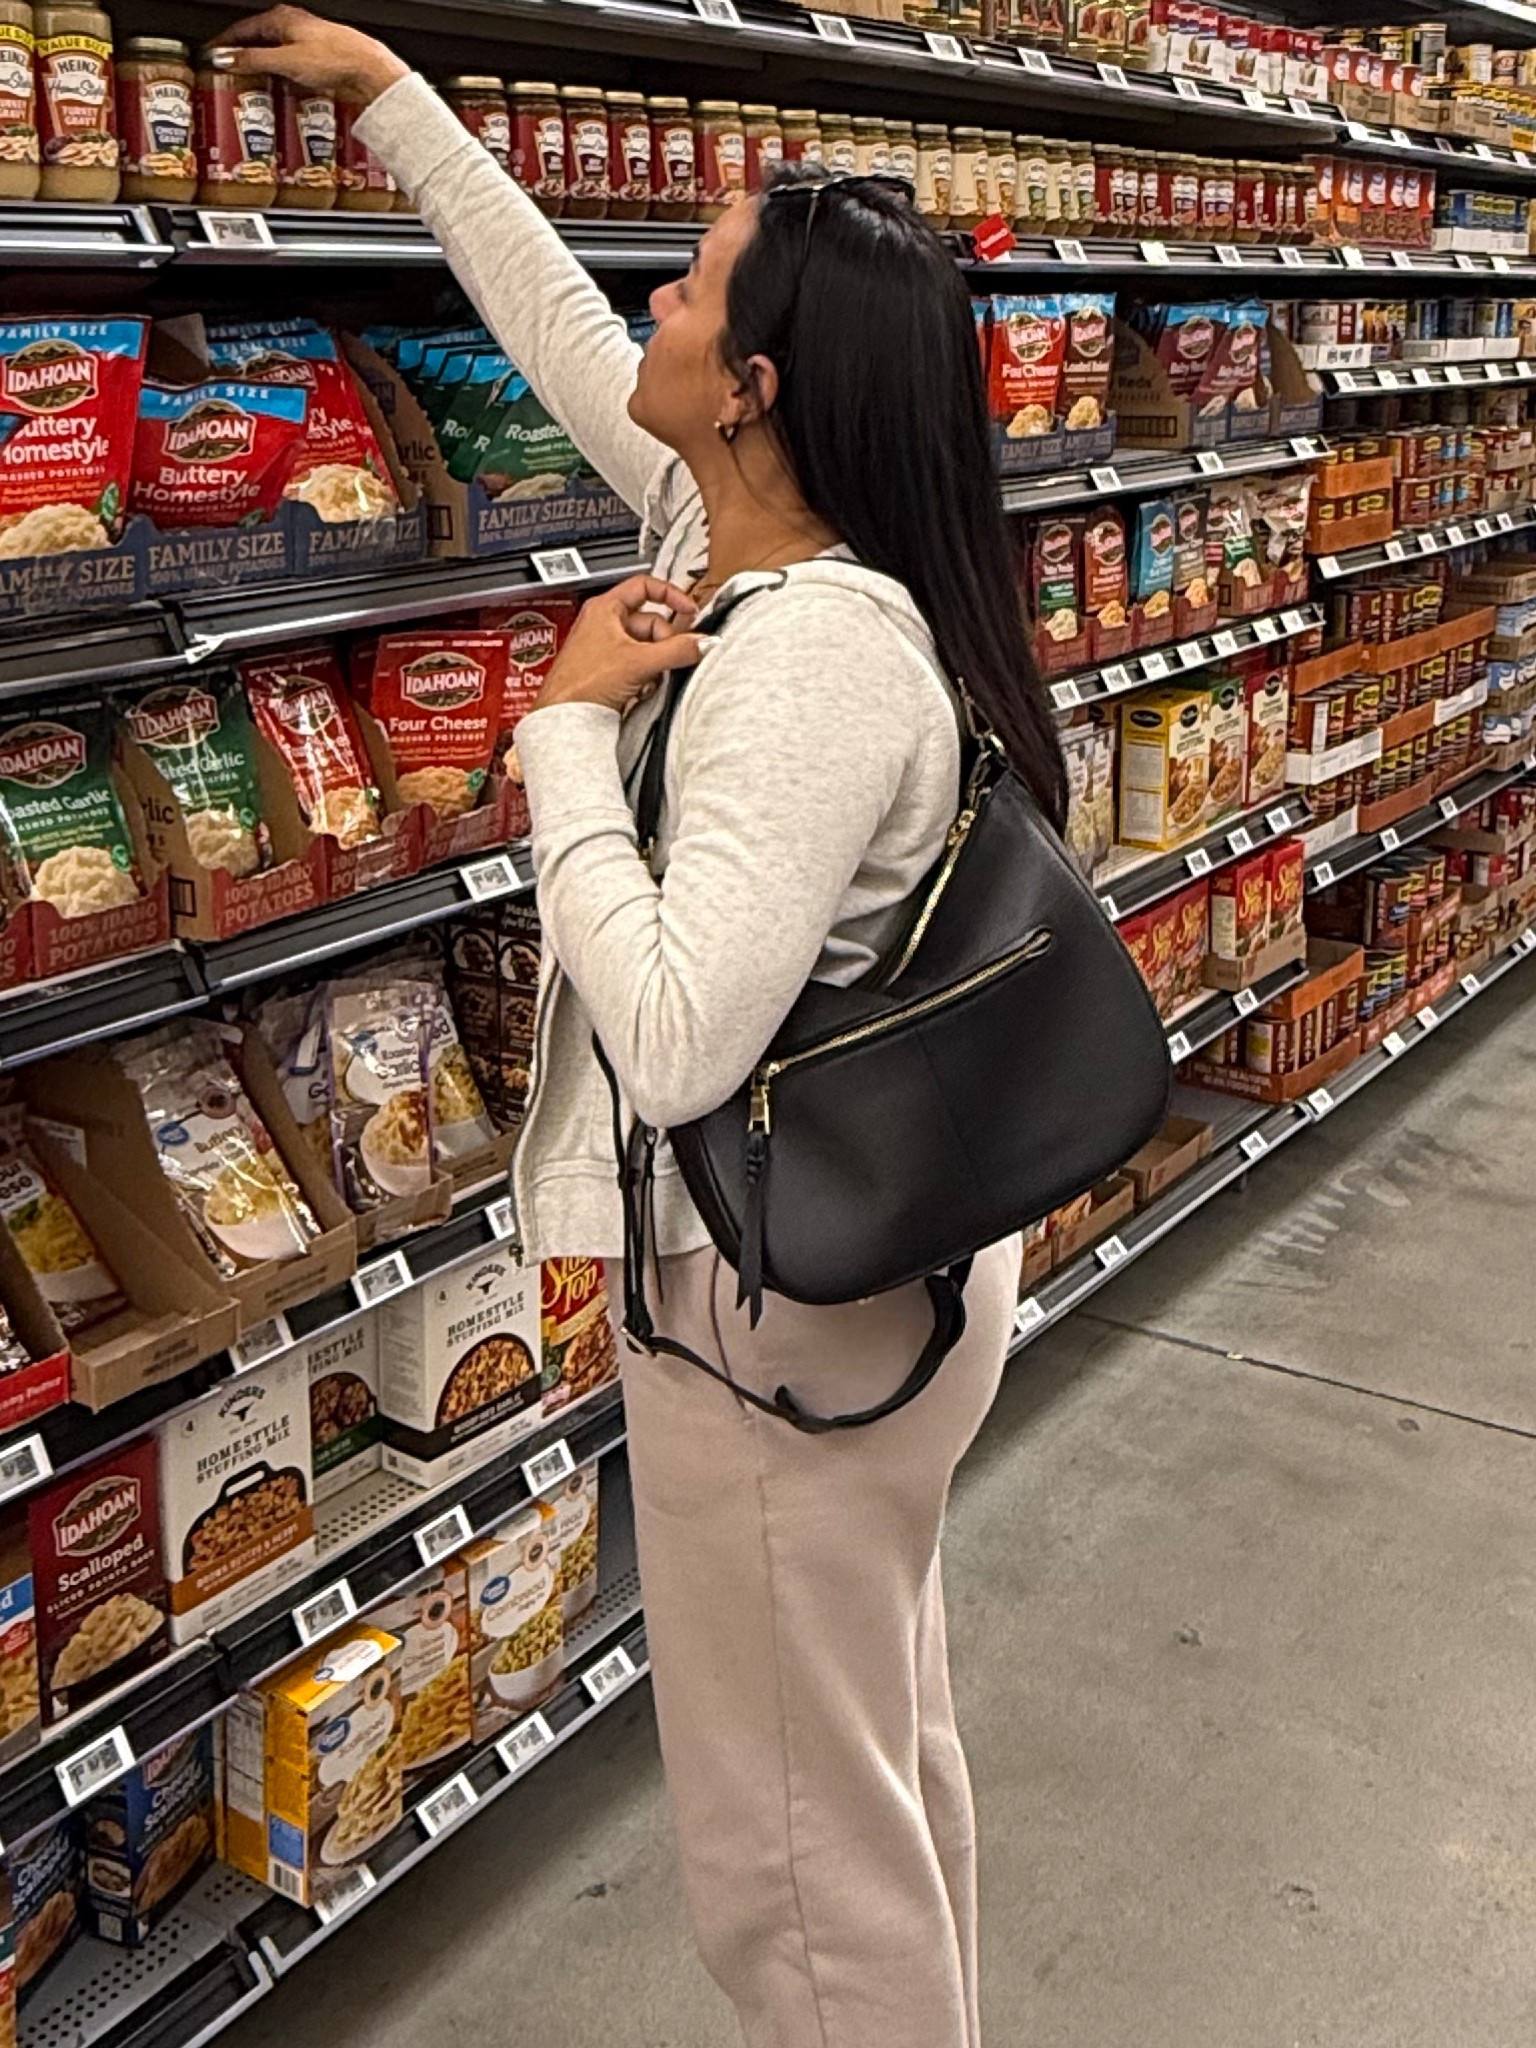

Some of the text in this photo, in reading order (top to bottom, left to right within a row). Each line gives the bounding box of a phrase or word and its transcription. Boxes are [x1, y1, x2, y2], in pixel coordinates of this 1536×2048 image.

[0, 51, 26, 66] EINZ
[57, 59, 99, 75] HEINZ
[154, 87, 187, 101] HEINZ
[64, 115, 97, 126] GRAVY
[69, 325, 108, 337] SIZE
[7, 359, 92, 394] IDAHOAN
[225, 385, 269, 399] SIZE
[167, 418, 250, 452] IDAHOAN
[133, 483, 262, 504] Homestyle
[159, 464, 248, 489] Buttery
[478, 496, 629, 532] FAMILY SIZE FAMIL
[148, 531, 286, 571] FAMILY SIZE
[78, 555, 135, 587] SIZE
[511, 628, 554, 651] AHOAN
[404, 670, 480, 696] IDAHOAN
[138, 699, 212, 738] IDAHOAN
[389, 715, 488, 732] Four Cheese
[2, 738, 80, 775] DAHOAN
[9, 790, 111, 819] oasted Garlic
[223, 881, 315, 929] POTATOES
[50, 919, 158, 968] POTATOES
[446, 1302, 525, 1348] STUFFING MIX
[447, 1290, 525, 1338] HOMESTYLE
[196, 1414, 290, 1473] HOMESTYLE
[196, 1426, 291, 1484] STUFFING MIX
[60, 1484, 136, 1549] IDAHOAN
[58, 1532, 145, 1592] Scalloped
